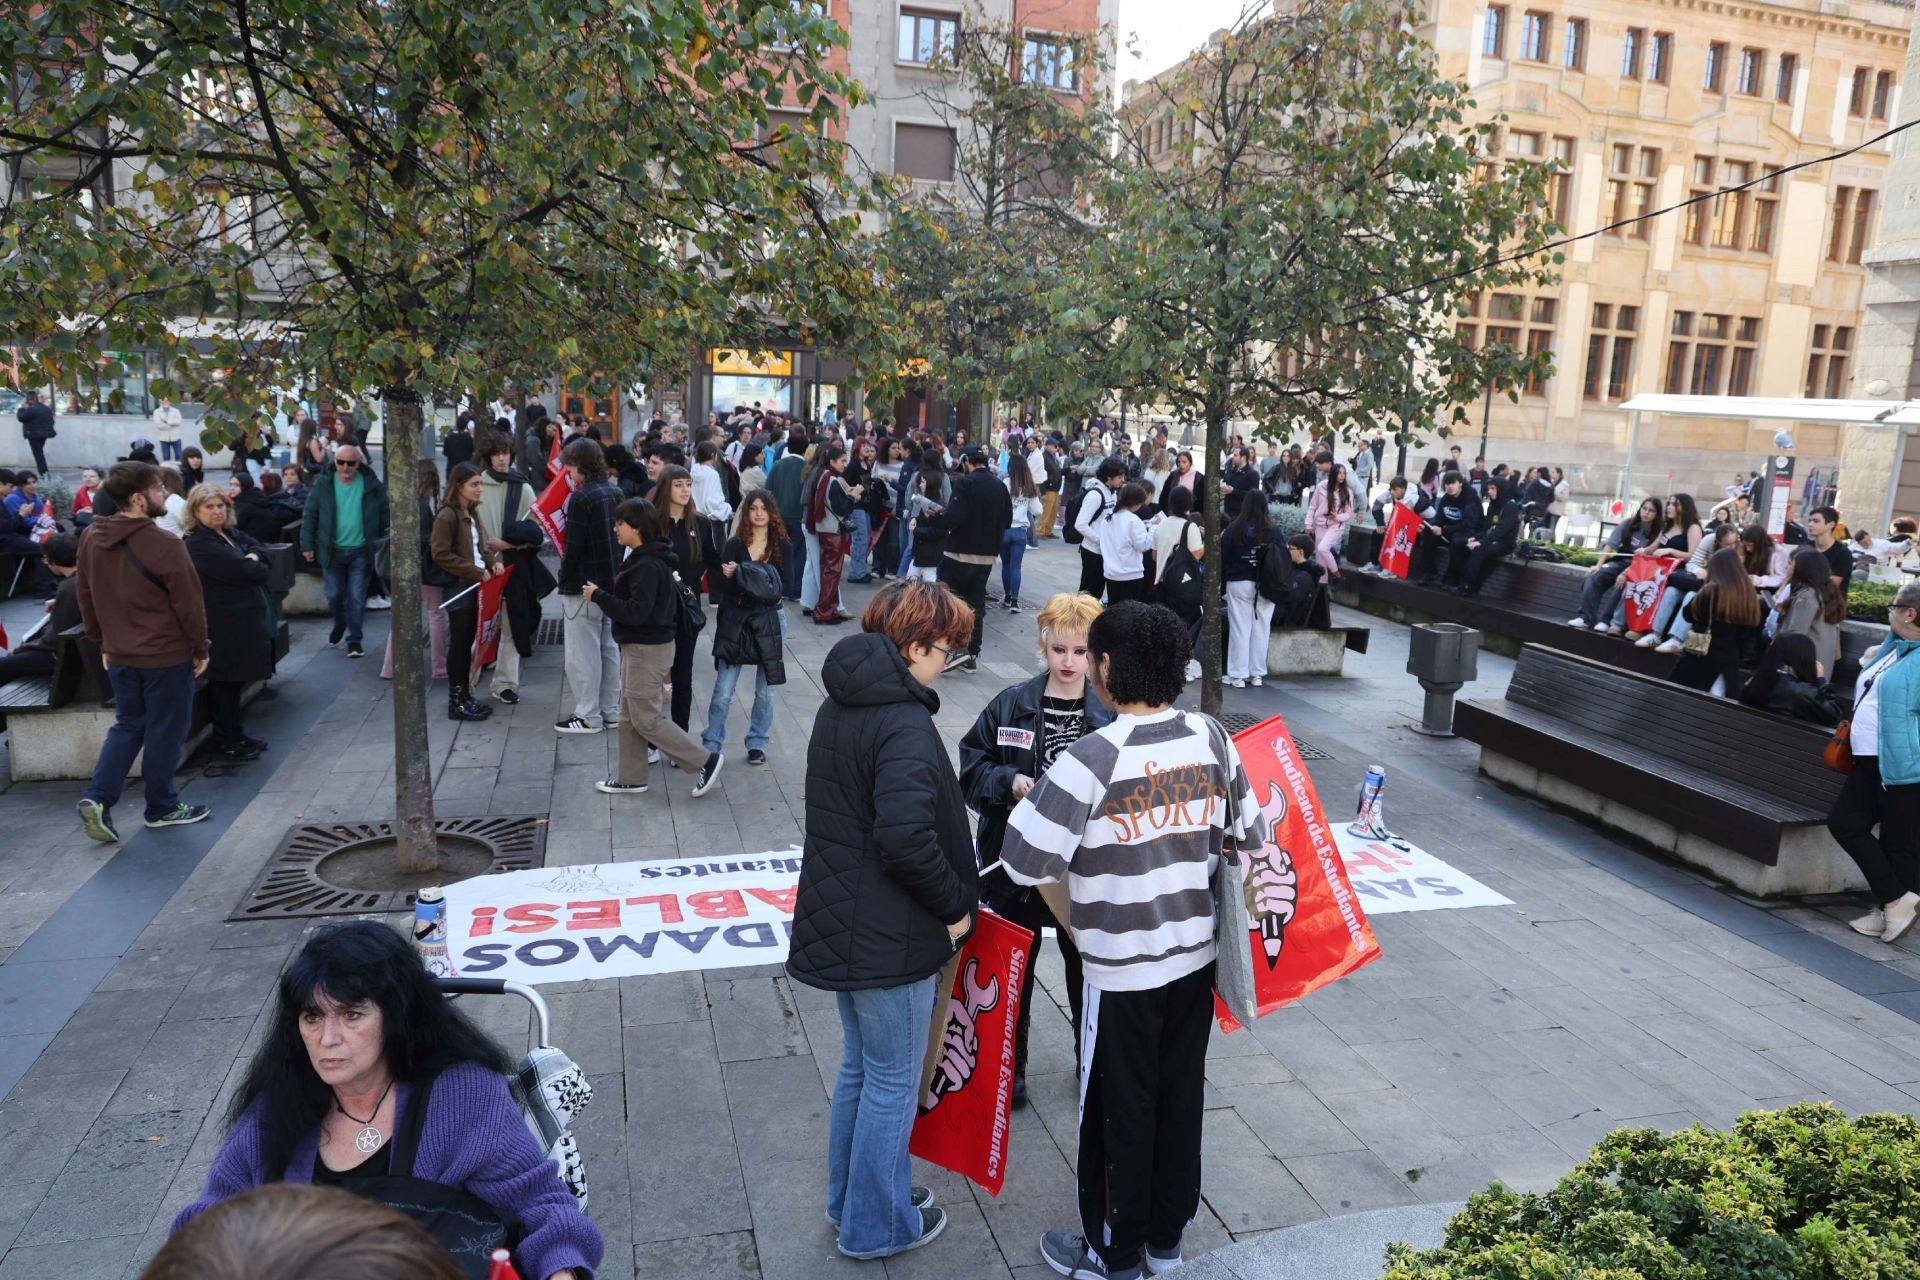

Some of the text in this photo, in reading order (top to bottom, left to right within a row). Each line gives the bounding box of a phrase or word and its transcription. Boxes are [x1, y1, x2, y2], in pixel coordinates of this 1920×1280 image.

[1144, 760, 1208, 792] Sorry,
[640, 857, 804, 879] diantes
[1271, 737, 1315, 823] Sindicato
[1308, 823, 1324, 847] de
[1316, 843, 1367, 952] Estudiantes
[469, 885, 798, 938] ABLES!
[462, 921, 791, 973] DAMOS
[988, 947, 1024, 1179] Sindicato de Estudiantes
